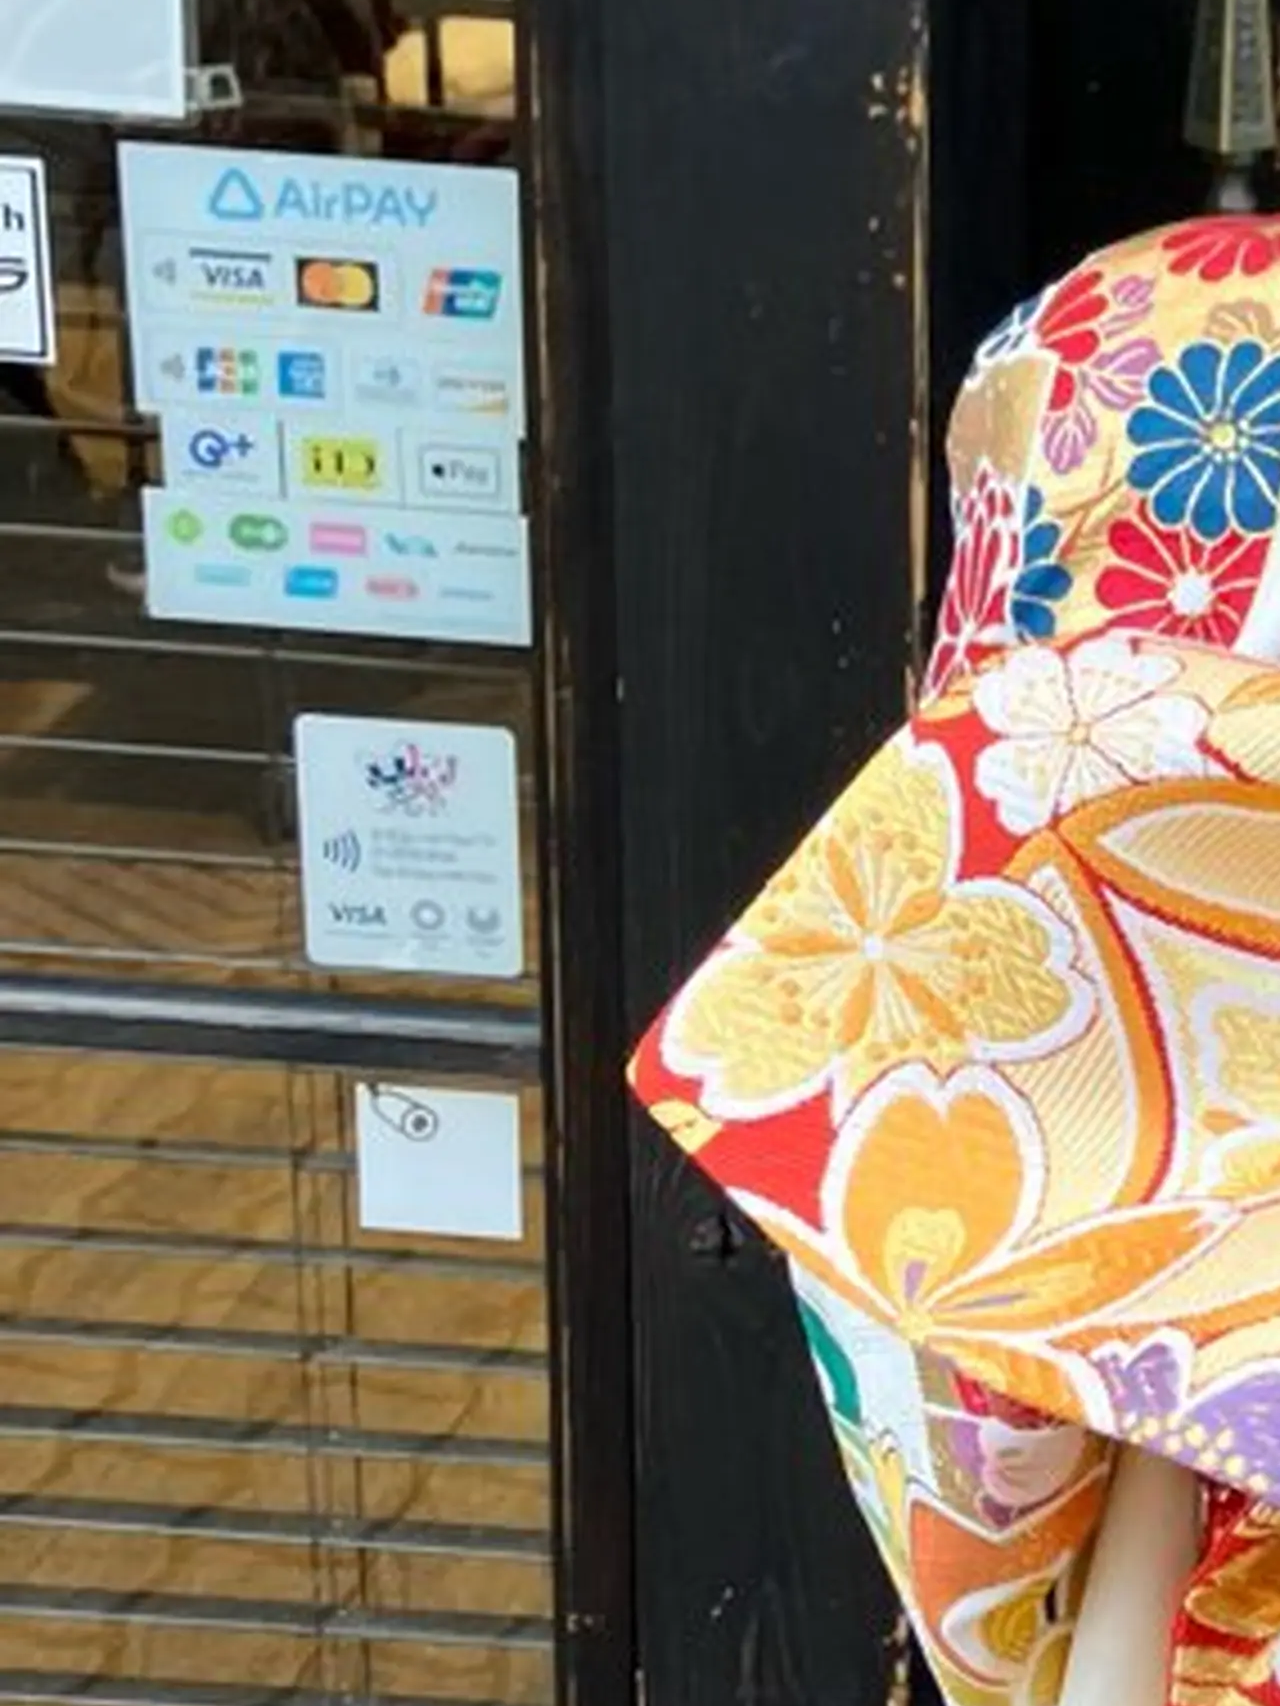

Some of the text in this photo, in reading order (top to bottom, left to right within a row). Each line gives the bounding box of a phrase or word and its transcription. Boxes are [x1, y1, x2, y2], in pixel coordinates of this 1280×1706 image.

[274, 176, 438, 227] AirPAY
[201, 262, 265, 289] VISA
[326, 901, 389, 927] VISA
